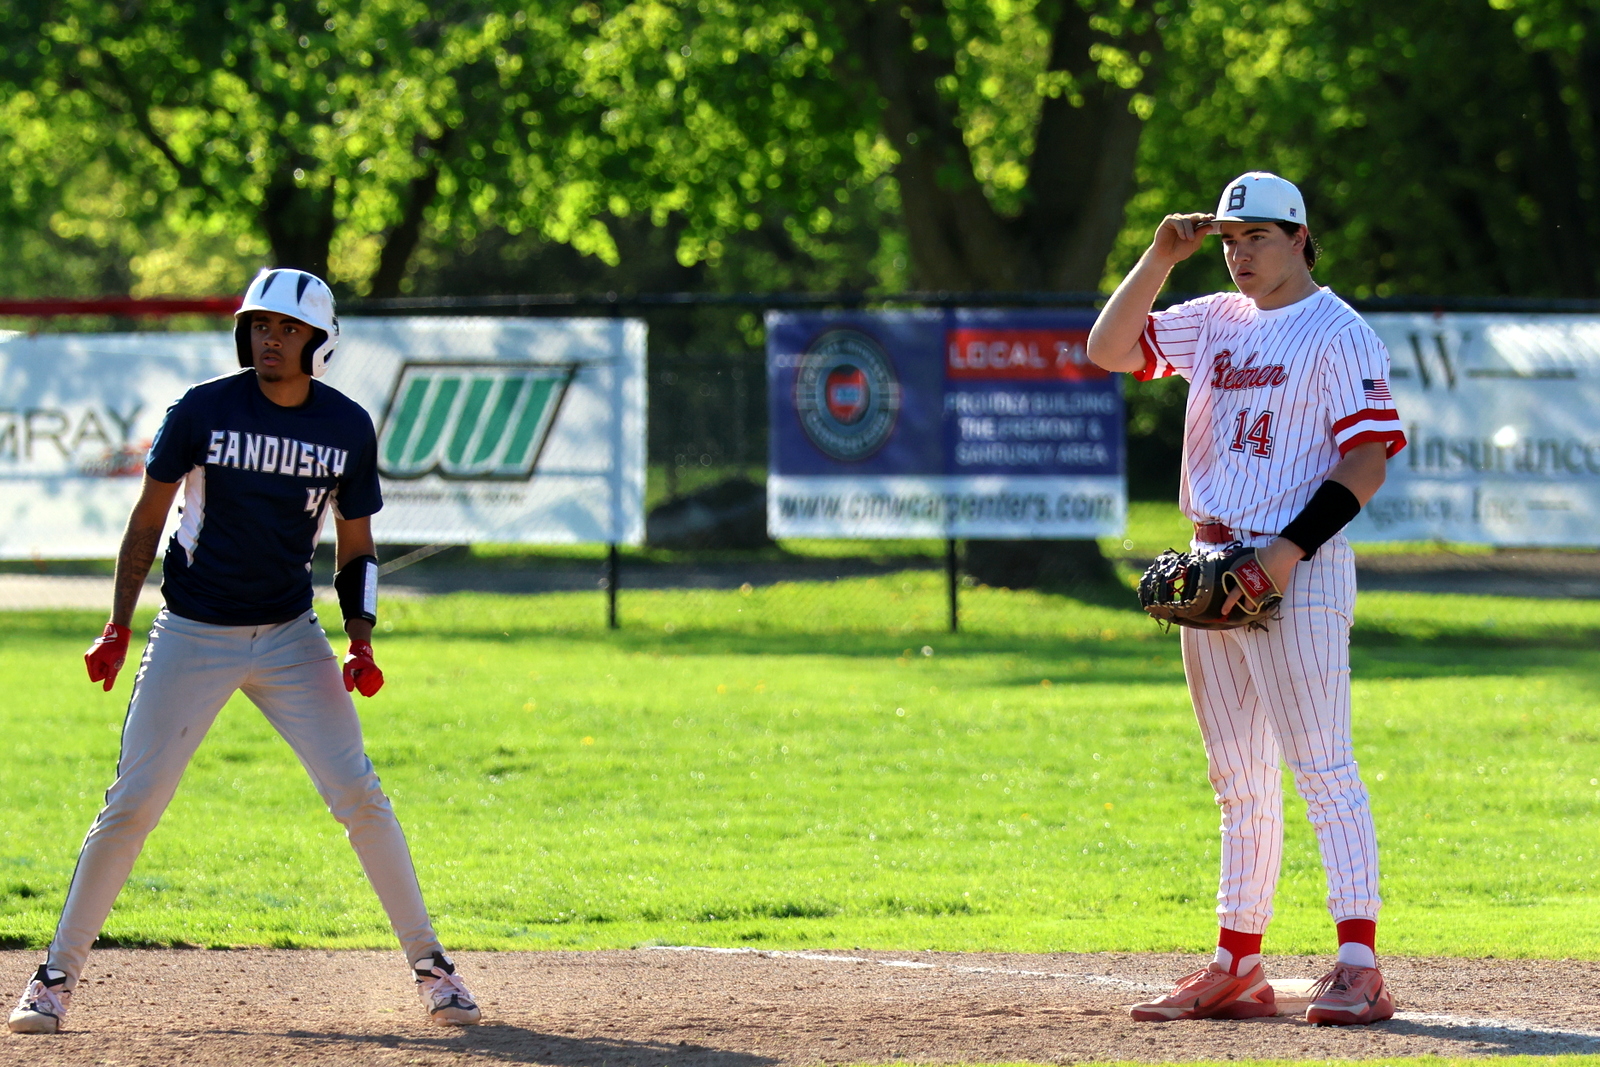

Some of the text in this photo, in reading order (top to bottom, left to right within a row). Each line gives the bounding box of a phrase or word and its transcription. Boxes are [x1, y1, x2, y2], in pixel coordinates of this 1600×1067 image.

[1225, 183, 1247, 213] B
[949, 340, 1090, 369] LOCAL 74
[957, 416, 996, 442] THE
[1229, 407, 1274, 459] 14
[206, 430, 349, 477] SANDUSKY
[304, 487, 328, 519] 4
